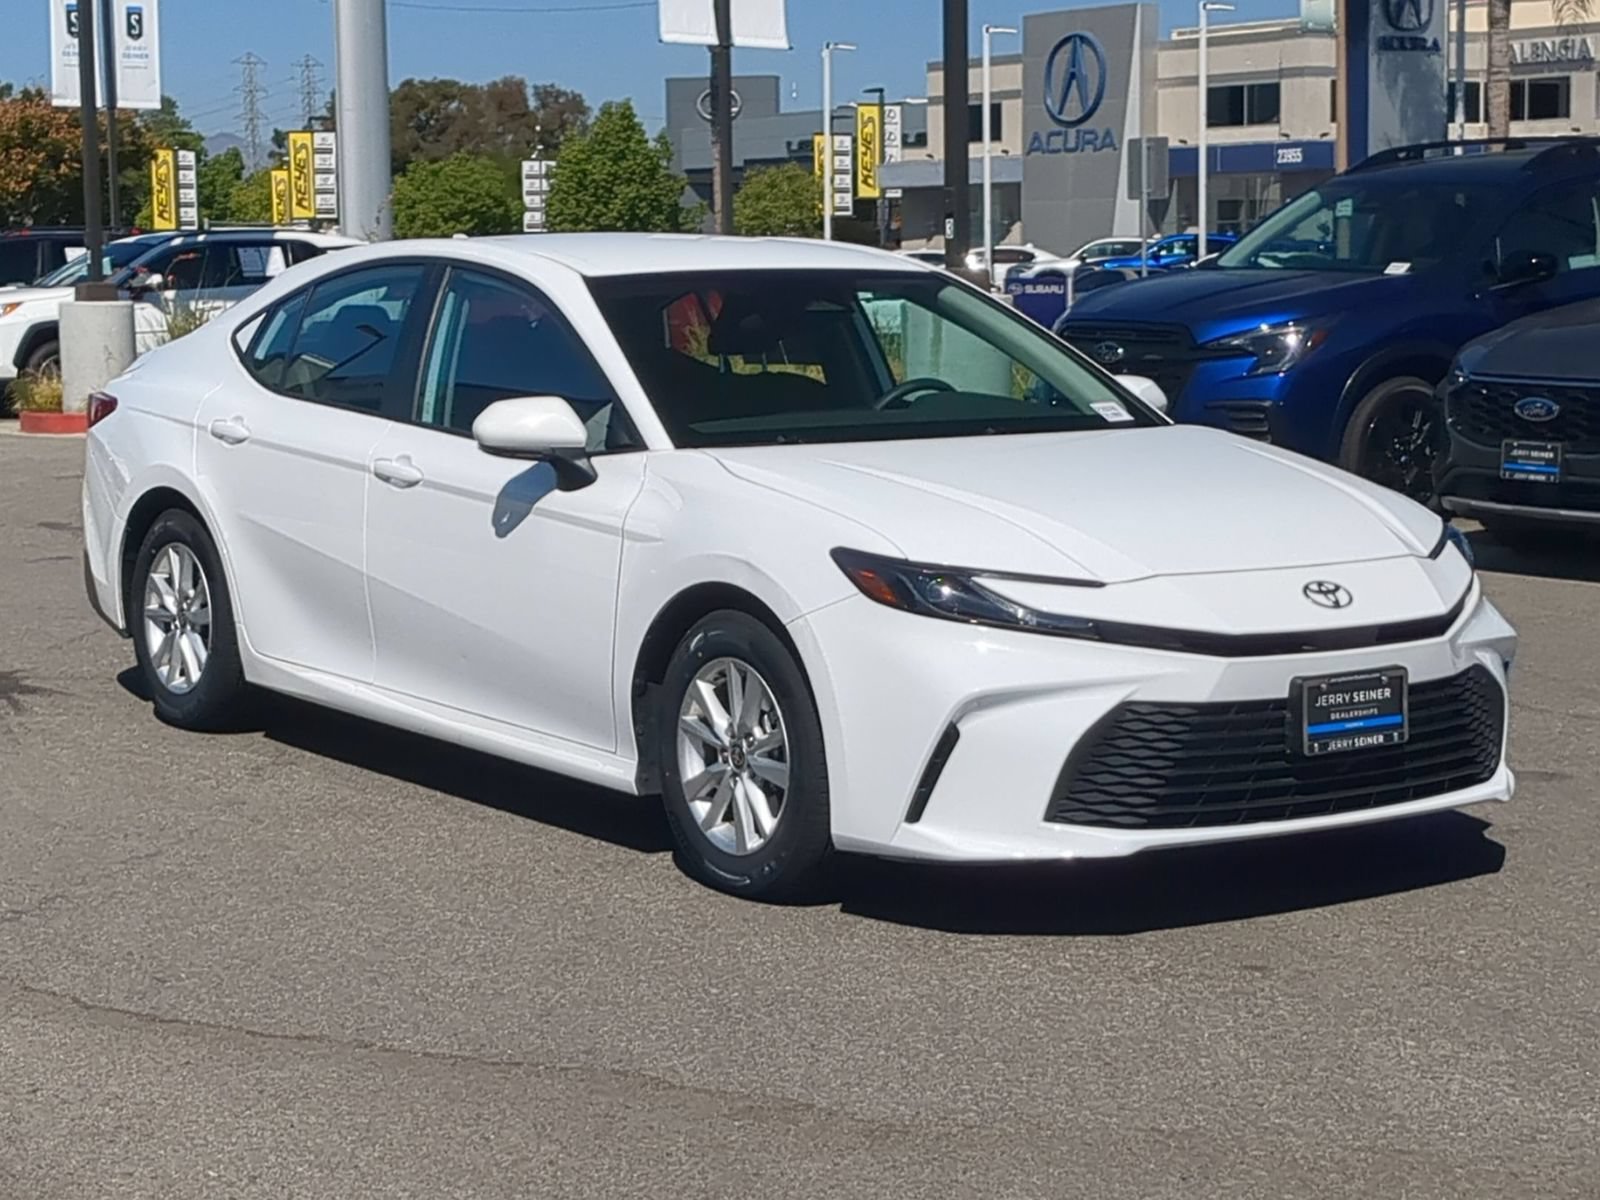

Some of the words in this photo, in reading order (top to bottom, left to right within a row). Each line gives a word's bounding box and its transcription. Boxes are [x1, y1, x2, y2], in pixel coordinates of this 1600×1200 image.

[1509, 37, 1591, 62] ALENCIA
[860, 112, 877, 190] KEYES
[1025, 128, 1118, 156] ACURA
[293, 139, 311, 213] KEYES
[1024, 284, 1065, 294] SUBARU
[1315, 693, 1350, 707] JERRY
[1352, 688, 1391, 703] SEINER
[1330, 708, 1378, 720] DEALERSHIPS
[1327, 739, 1352, 751] JERRY
[1354, 735, 1384, 748] SEINER
